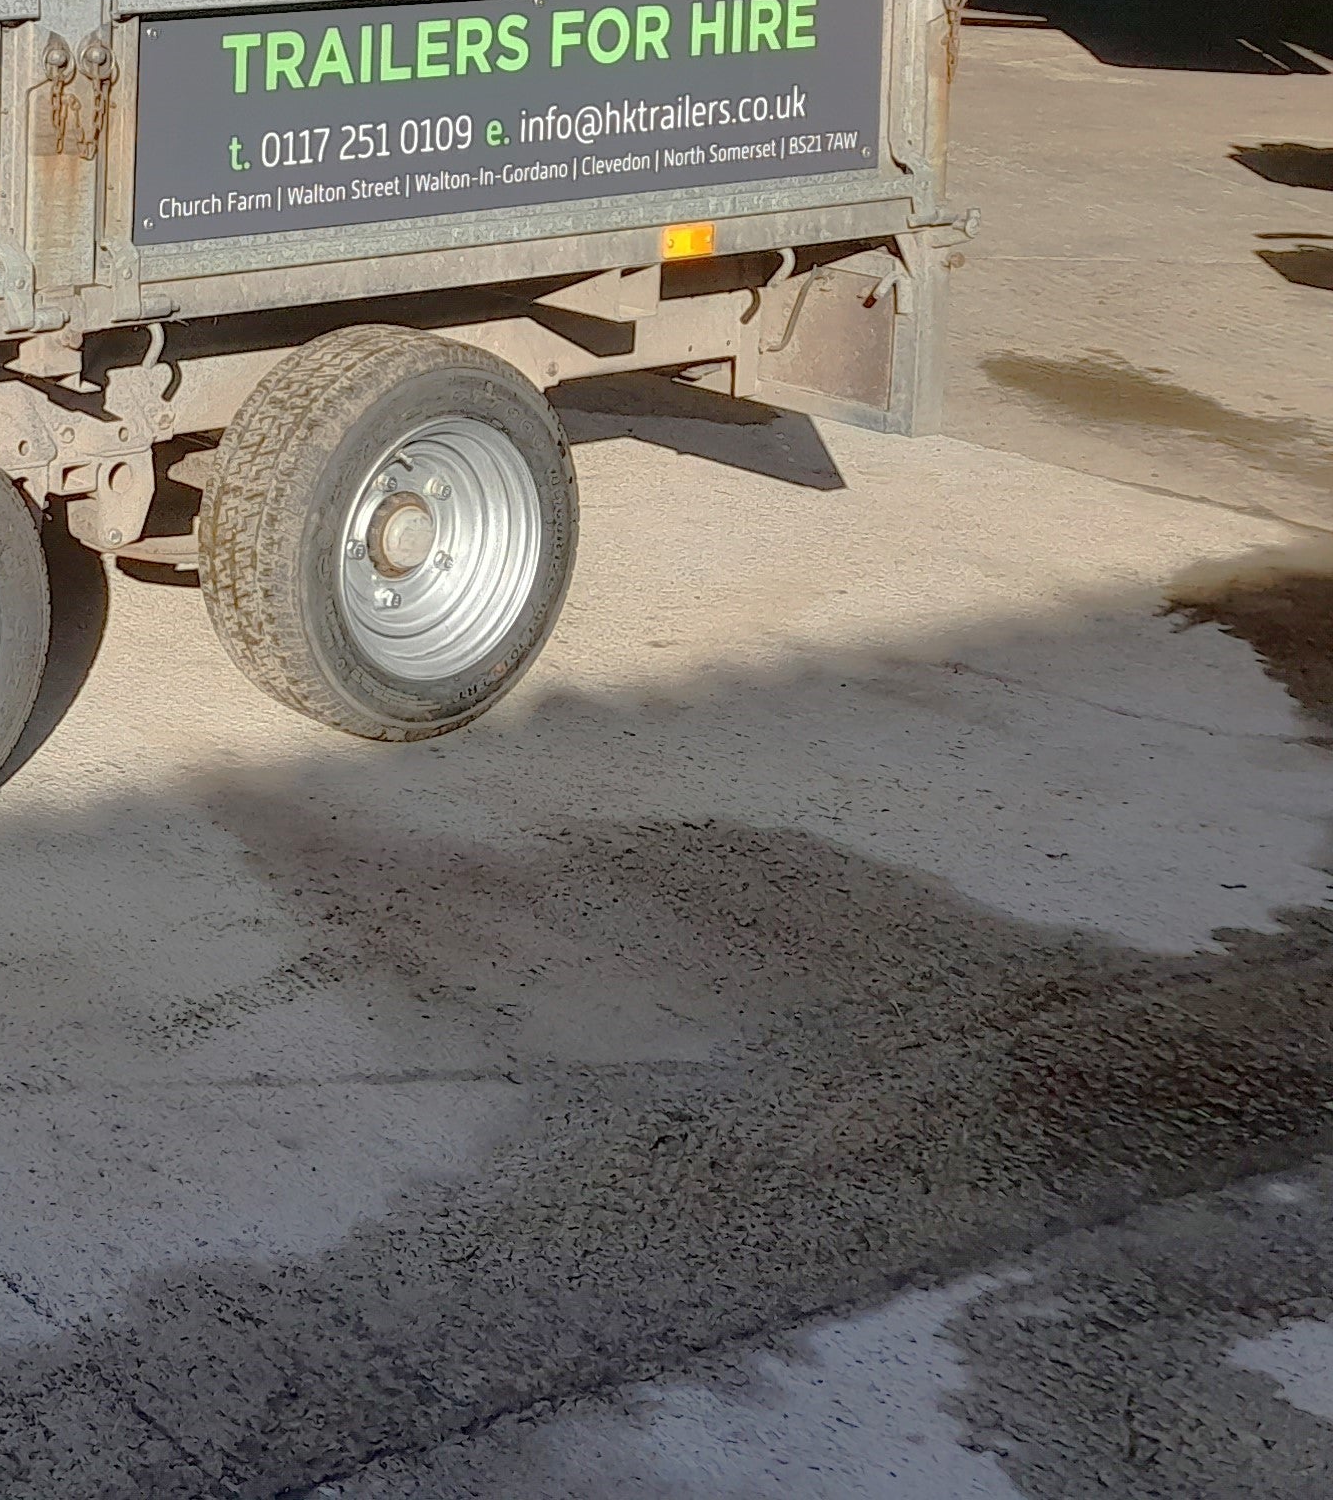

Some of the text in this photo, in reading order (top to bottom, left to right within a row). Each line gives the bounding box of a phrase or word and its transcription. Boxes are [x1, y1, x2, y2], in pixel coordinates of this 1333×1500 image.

[221, 14, 532, 94] TRAILERS
[549, 4, 674, 68] FOR
[261, 127, 331, 168] 0117
[339, 122, 391, 161] 251
[400, 114, 472, 155] 0109
[485, 119, 511, 147] e.
[519, 84, 807, 145] info@hktrailers.co.uk
[159, 131, 858, 219] Church Farm Walton Street Walton-In-Gordano Clevedon North Somerset BS21 7AW
